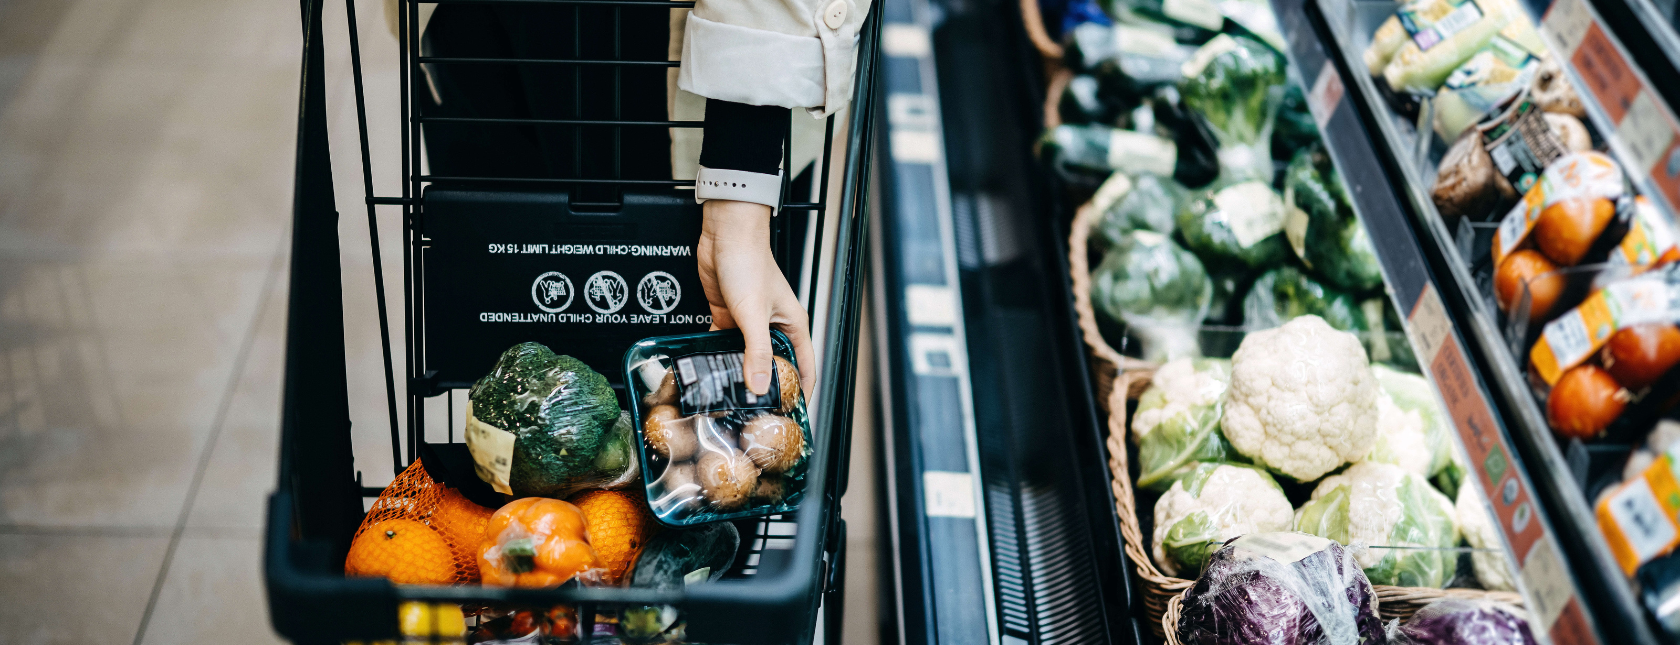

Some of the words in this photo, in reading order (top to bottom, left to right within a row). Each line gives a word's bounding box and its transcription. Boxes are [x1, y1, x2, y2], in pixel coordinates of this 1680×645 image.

[488, 243, 505, 254] KG
[507, 243, 519, 254] 15
[521, 244, 548, 254] LIMIT
[550, 244, 594, 255] WEIGHT
[479, 312, 556, 323] UNATTENDED
[558, 313, 593, 323] CHILD
[595, 314, 628, 324] YOUR
[630, 314, 667, 324] LEAVE
[670, 314, 693, 324] NOT
[695, 314, 713, 324] DO
